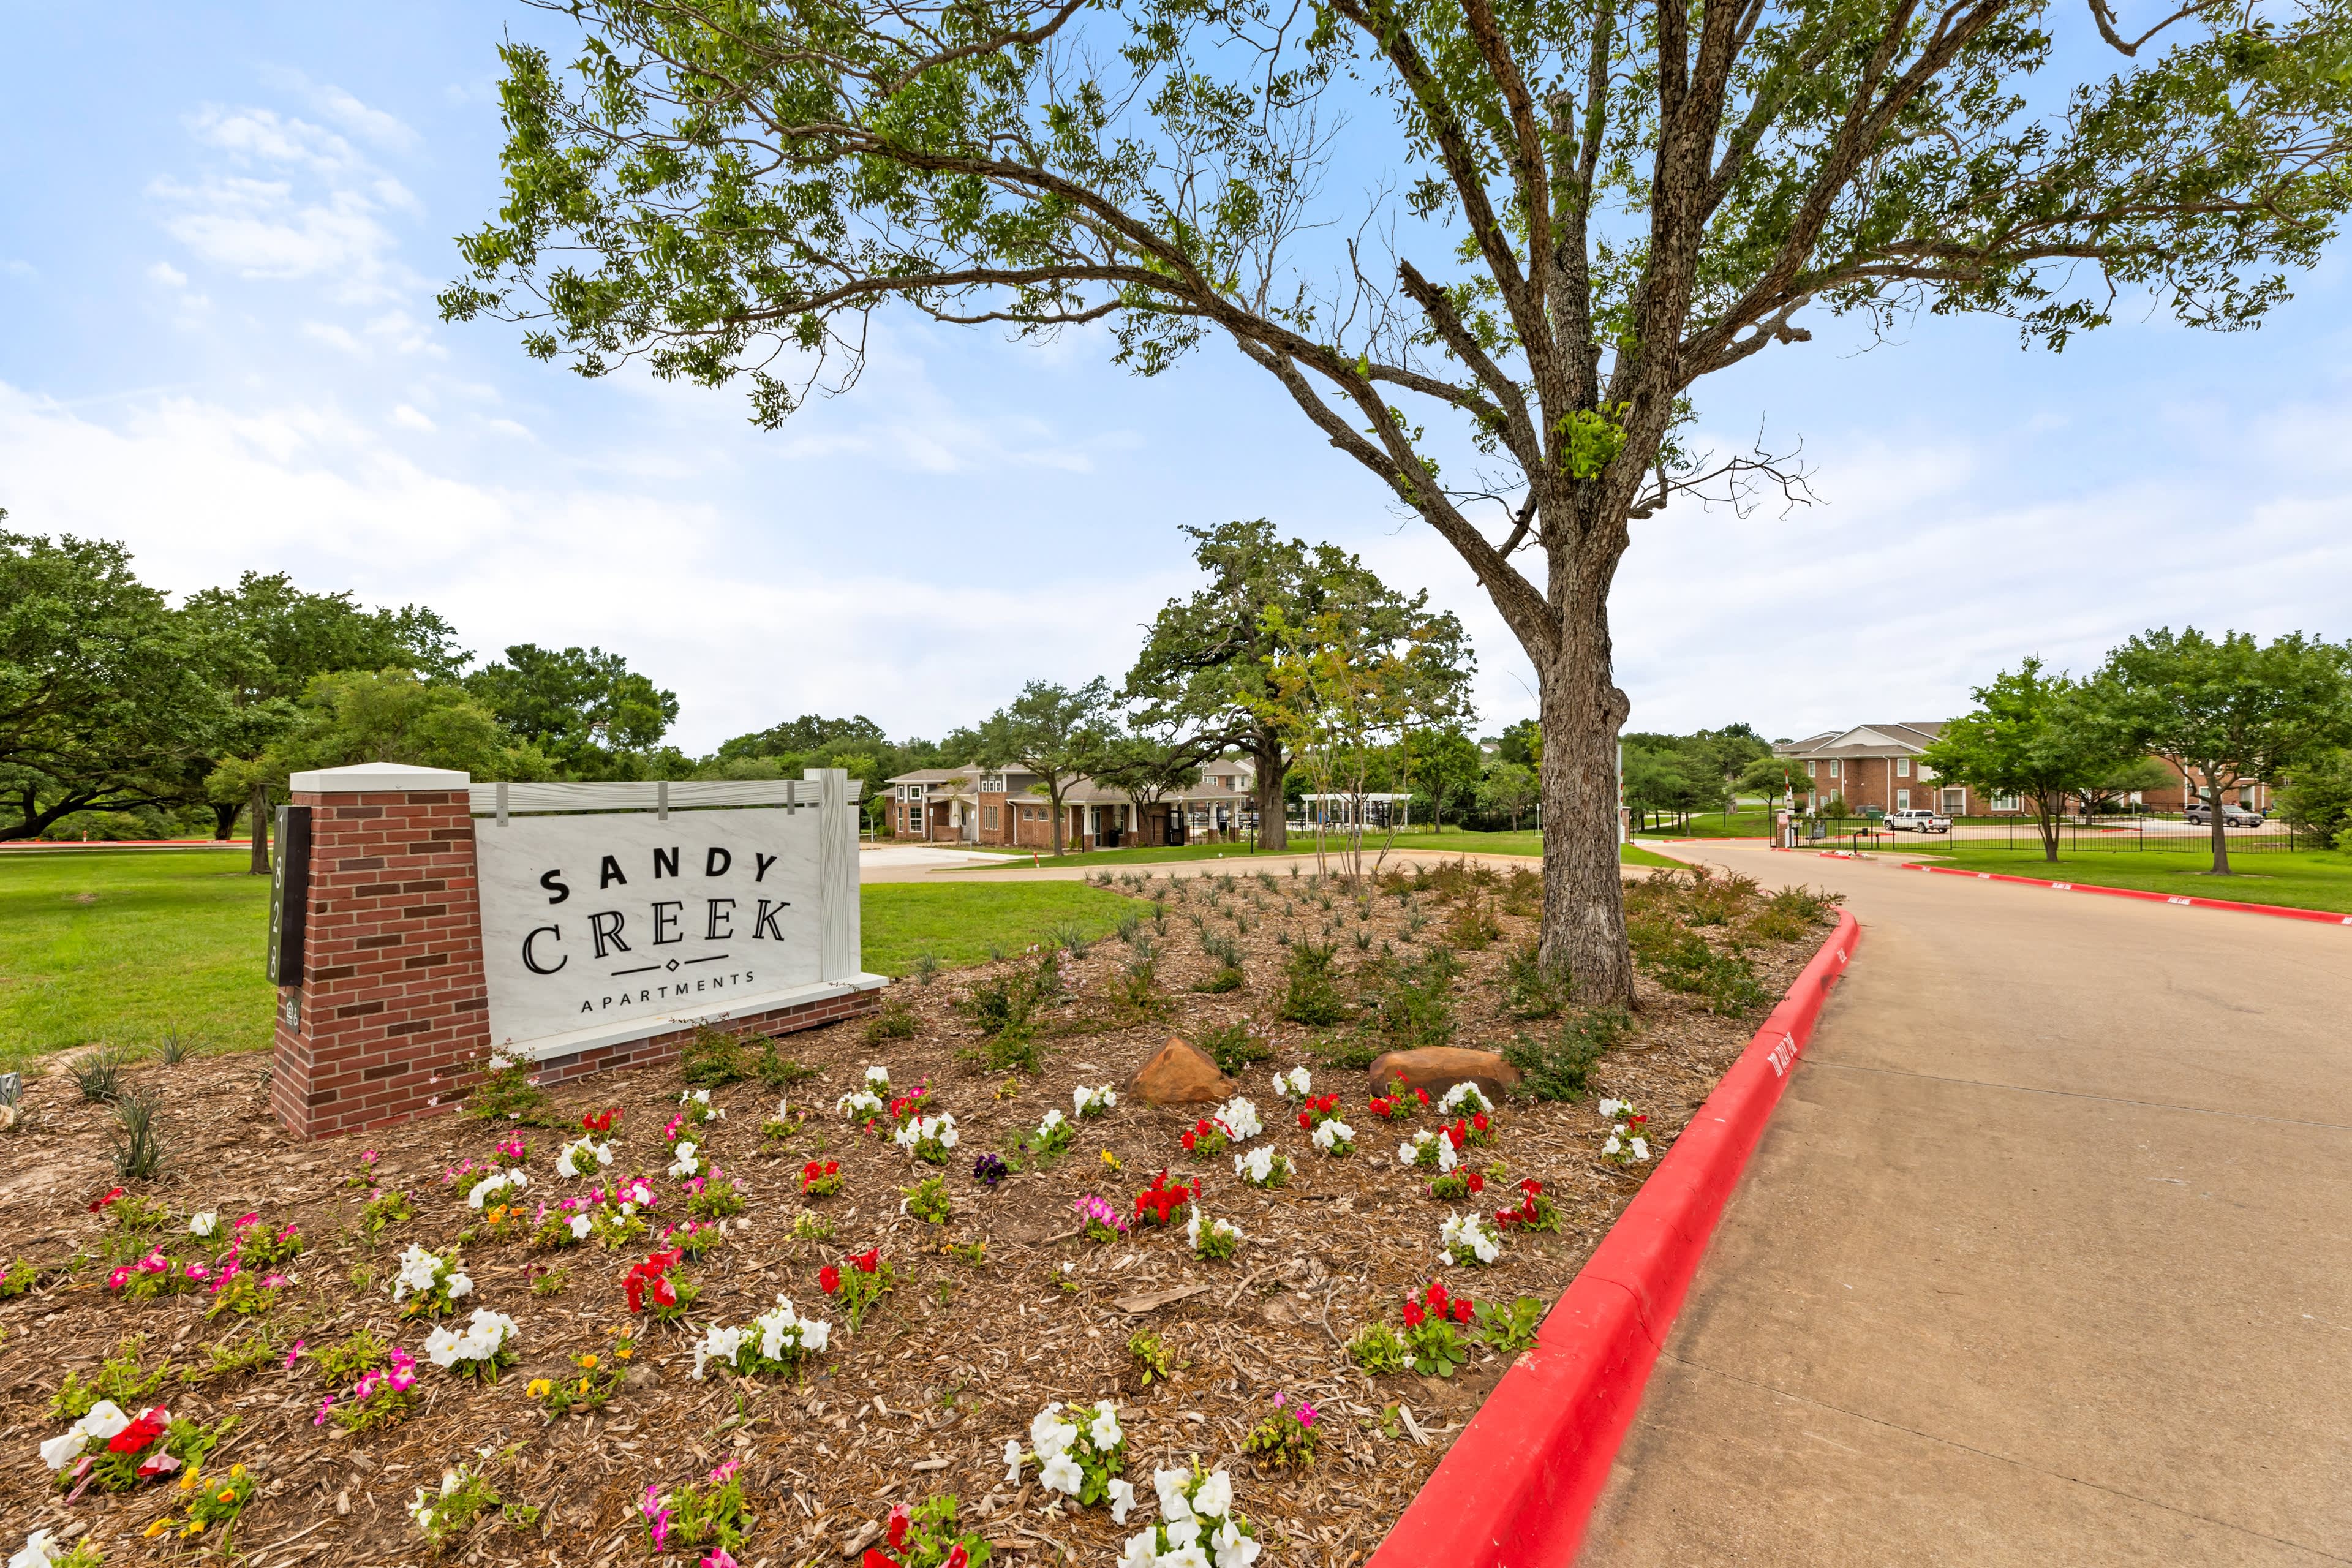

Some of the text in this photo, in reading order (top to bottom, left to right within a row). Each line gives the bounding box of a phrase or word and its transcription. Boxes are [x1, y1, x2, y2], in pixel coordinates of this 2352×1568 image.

[270, 812, 283, 978] 1828
[540, 846, 777, 905] SANDY
[522, 899, 790, 974] CREEK
[581, 971, 754, 1013] APARTMENTS
